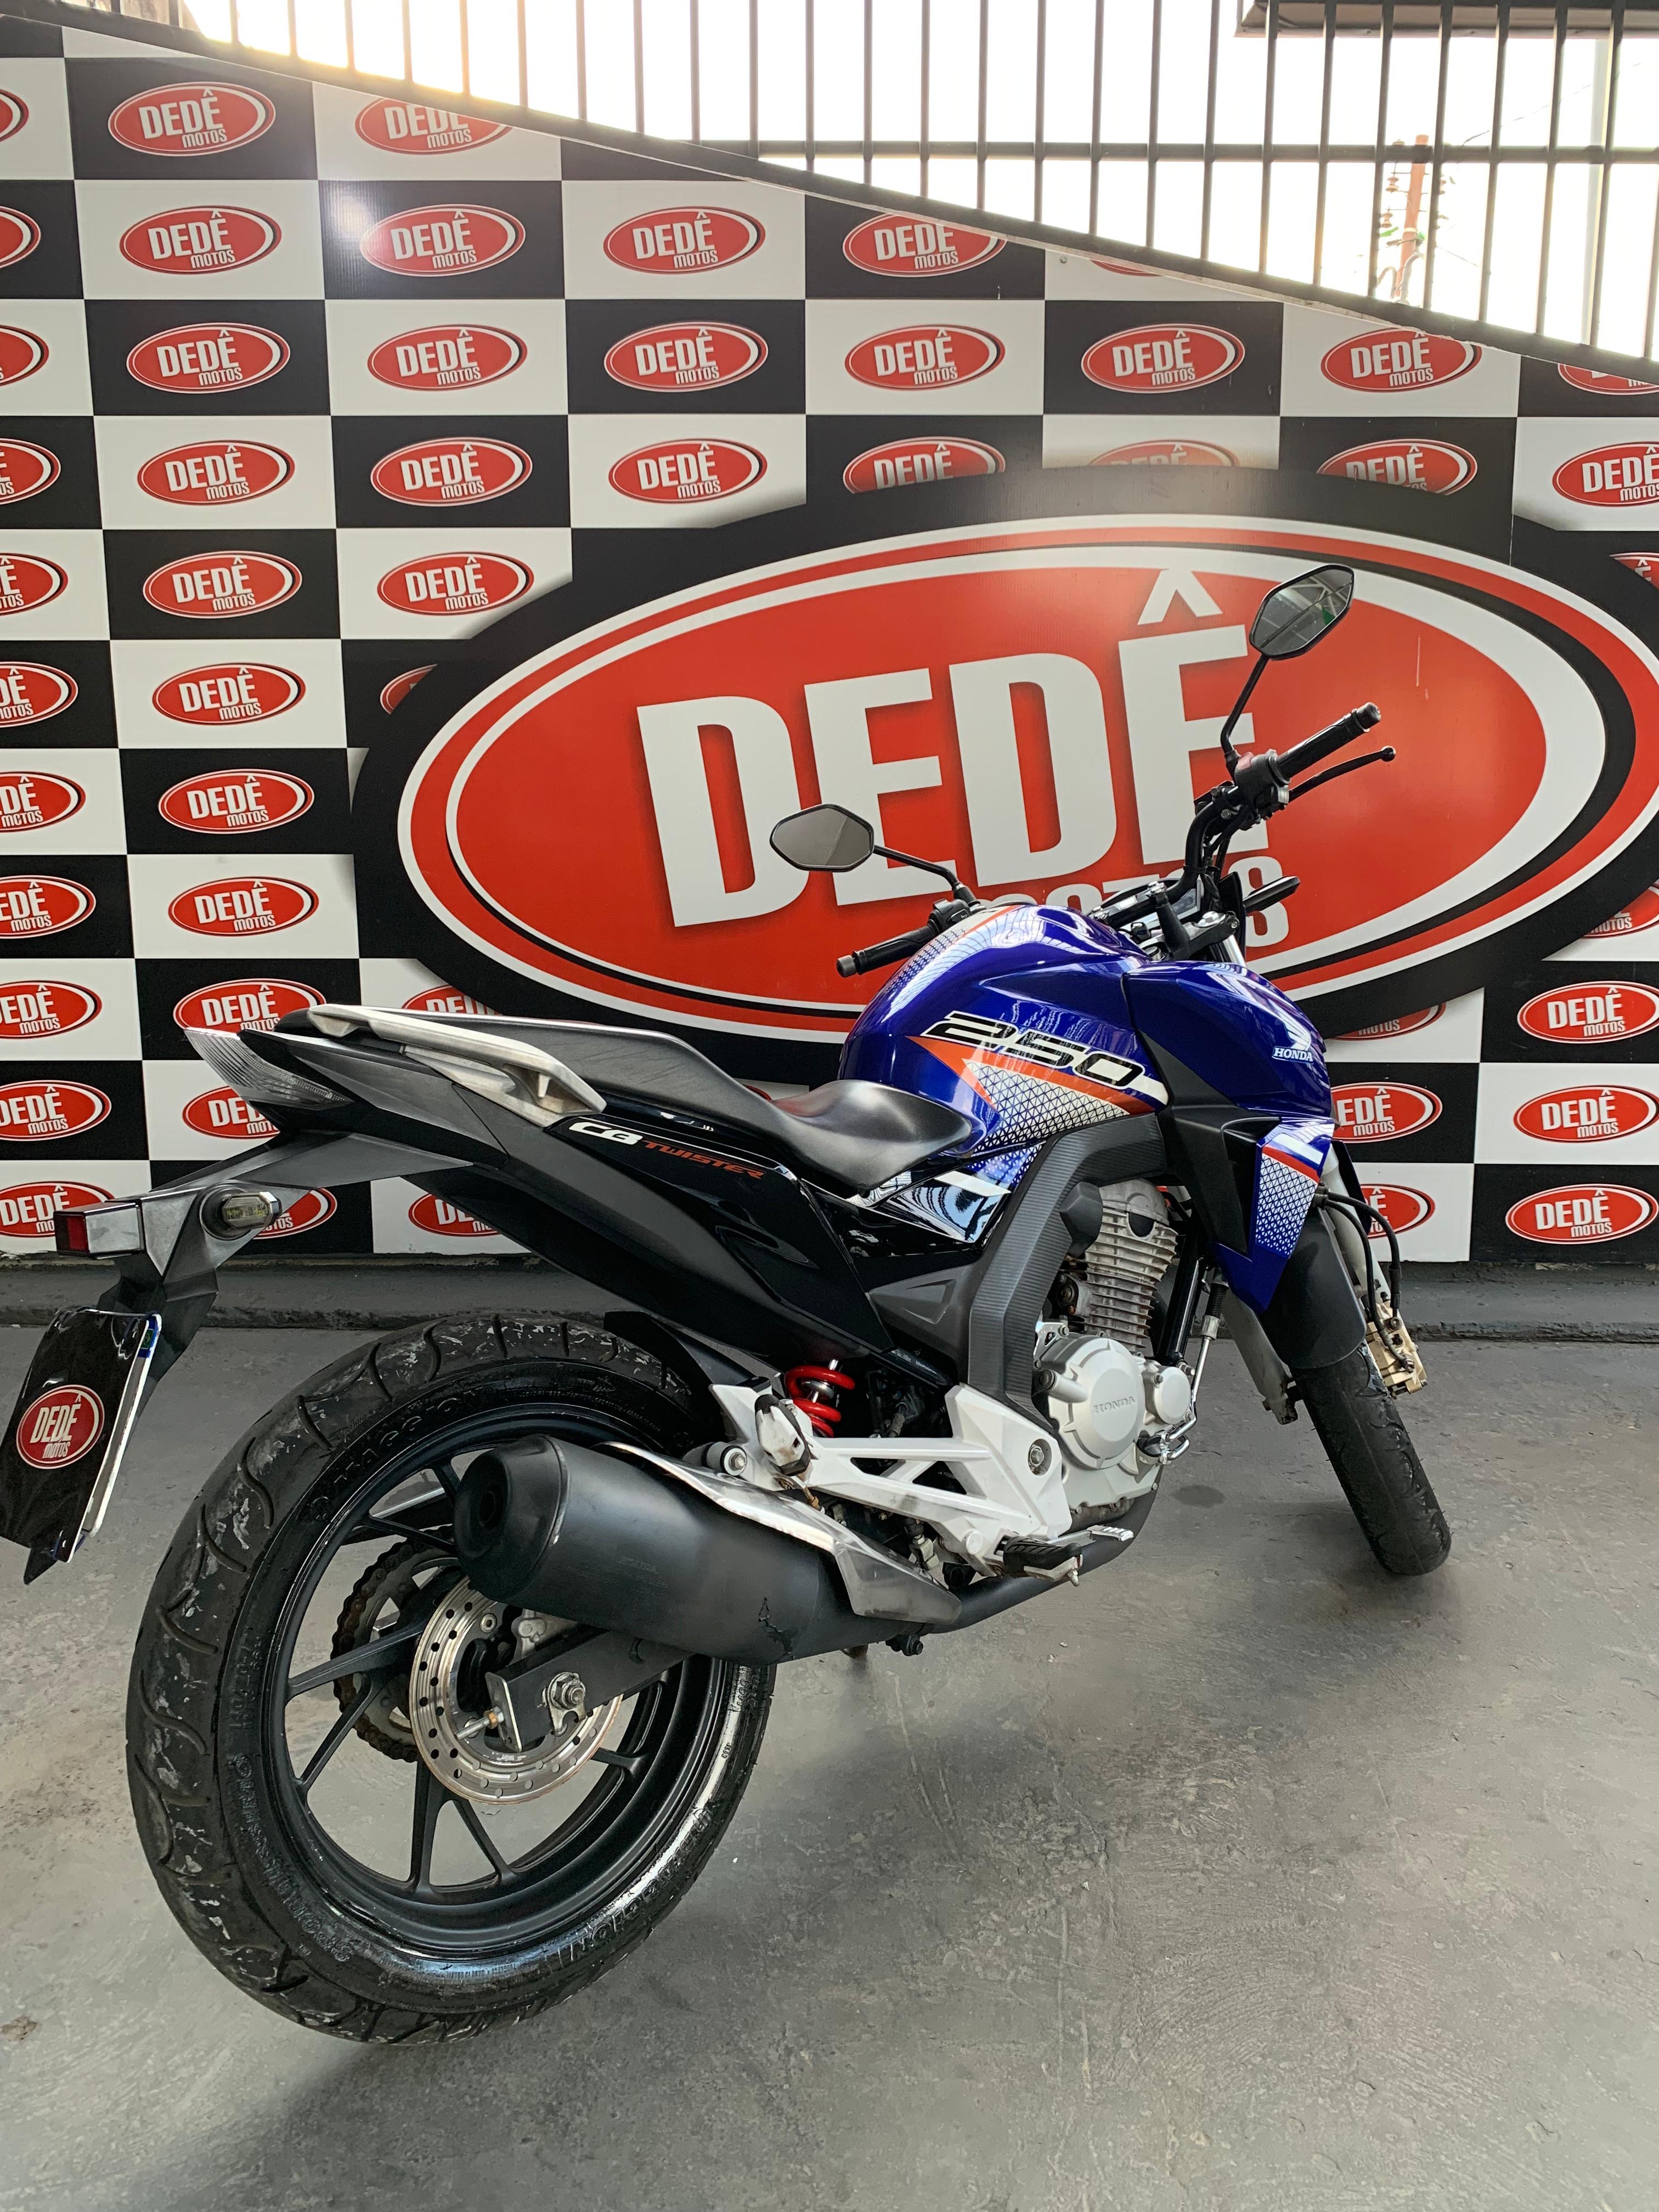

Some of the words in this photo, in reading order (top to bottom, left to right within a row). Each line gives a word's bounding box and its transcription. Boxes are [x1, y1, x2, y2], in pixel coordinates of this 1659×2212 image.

[139, 89, 223, 139] DEDÊ
[182, 128, 227, 148] MOTOS
[427, 129, 472, 148] MOTOS
[148, 211, 231, 259] DEDÊ
[391, 211, 473, 261] DEDÊ
[633, 210, 715, 259] DEDÊ
[190, 250, 235, 268] MOTOS
[432, 250, 477, 269] MOTOS
[674, 249, 718, 268] MOTOS
[915, 251, 958, 269] MOTOS
[156, 329, 239, 377] DEDÊ
[396, 329, 478, 377] DEDÊ
[635, 327, 716, 376] DEDÊ
[874, 329, 955, 376] DEDÊ
[1112, 329, 1193, 377] DEDÊ
[1351, 331, 1431, 379] DEDÊ
[199, 367, 243, 386] MOTOS
[437, 367, 481, 386] MOTOS
[675, 366, 719, 384] MOTOS
[913, 366, 958, 385] MOTOS
[1152, 367, 1196, 386] MOTOS
[1389, 368, 1434, 387] MOTOS
[165, 444, 246, 492] DEDÊ
[400, 443, 481, 491] DEDÊ
[637, 442, 718, 490] DEDÊ
[873, 442, 952, 489] DEDÊ
[206, 482, 250, 500] MOTOS
[441, 481, 485, 499] MOTOS
[677, 481, 721, 498] MOTOS
[172, 557, 252, 604] DEDÊ
[405, 556, 485, 602] DEDÊ
[0, 594, 24, 608] TOS
[213, 594, 256, 612] MOTOS
[445, 592, 489, 611] MOTOS
[178, 667, 258, 712] DEDÊ
[219, 703, 262, 720] MOTOS
[637, 568, 1268, 928] DEDÊ
[0, 776, 40, 815] DÊ
[187, 775, 265, 820] DEDÊ
[226, 810, 269, 827] MOTOS
[0, 881, 48, 921] EDÊ
[194, 881, 272, 924] DEDÊ
[10, 915, 53, 932] MOTOS
[233, 915, 276, 932] MOTOS
[0, 984, 57, 1025] EDÊ
[201, 984, 278, 1026] DEDÊ
[1547, 986, 1624, 1029] DEDÊ
[20, 1018, 61, 1035] MOTOS
[1583, 1020, 1625, 1037] MOTOS
[920, 1010, 1144, 1089] 250
[1274, 1047, 1313, 1062] HONDA
[1338, 1088, 1394, 1125] EDÊ
[1541, 1088, 1618, 1131] DEDÊ
[28, 1119, 69, 1135] MOTOS
[1353, 1120, 1395, 1137] MOTOS
[1577, 1121, 1618, 1138] MOTOS
[568, 1122, 643, 1145] CB
[643, 1140, 766, 1180] TWISTER
[1534, 1188, 1612, 1230] DEDÊ
[1571, 1221, 1612, 1238] MOTOS
[30, 1393, 81, 1443] DEDÊ
[1093, 1396, 1136, 1413] HONDA
[42, 1441, 70, 1459] MOTOS
